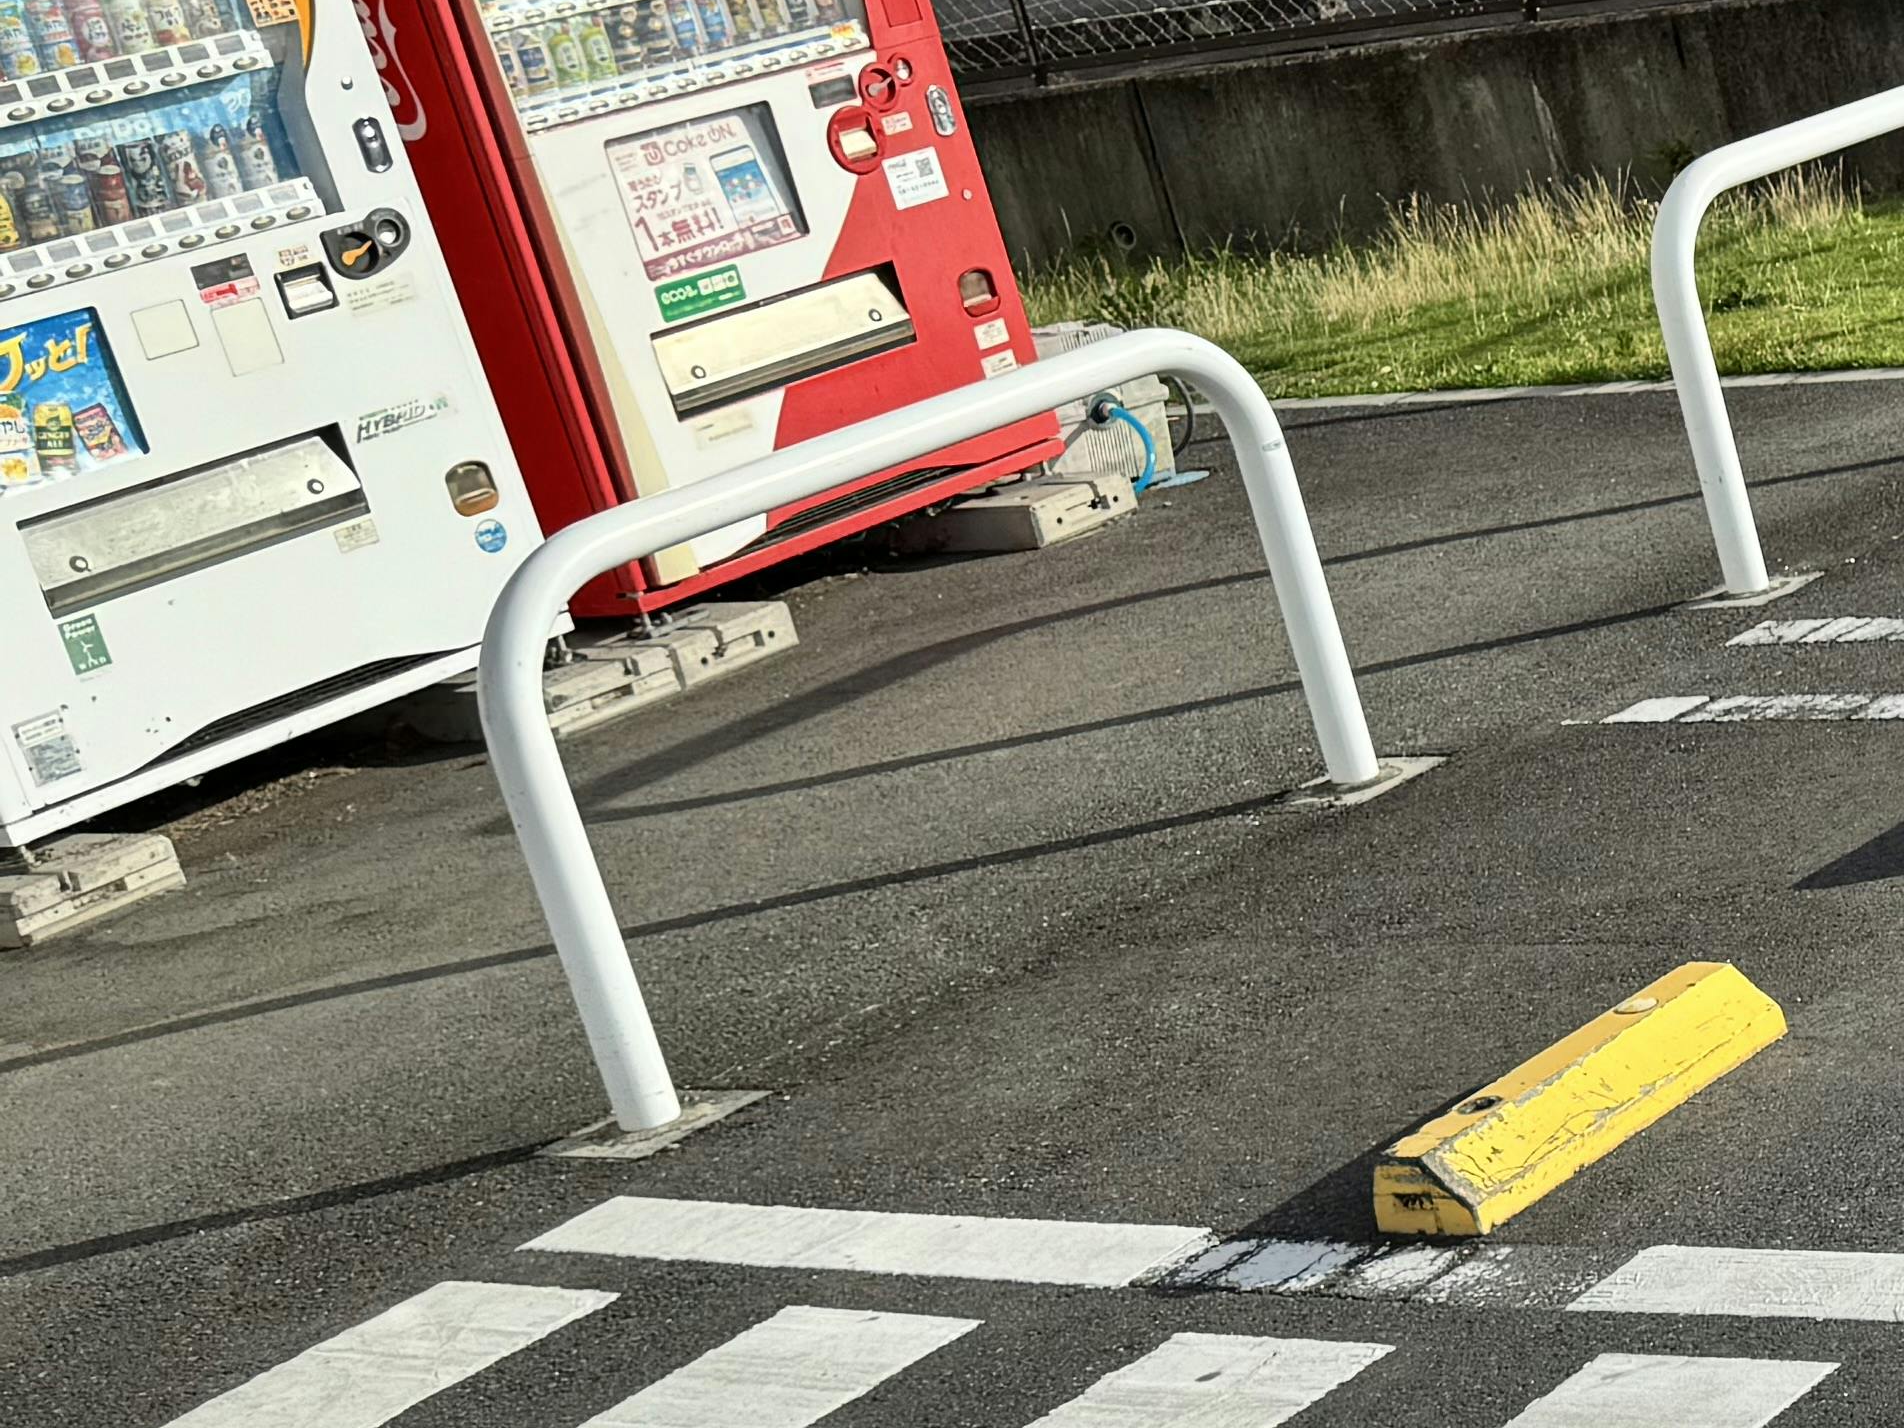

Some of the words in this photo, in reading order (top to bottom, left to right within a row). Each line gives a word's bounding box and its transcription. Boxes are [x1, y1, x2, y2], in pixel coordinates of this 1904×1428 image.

[664, 132, 707, 156] Coke
[708, 123, 736, 142] ON
[633, 179, 682, 213] スタンプ
[634, 207, 724, 252] 1本無料!
[356, 405, 425, 444] HYBRID
